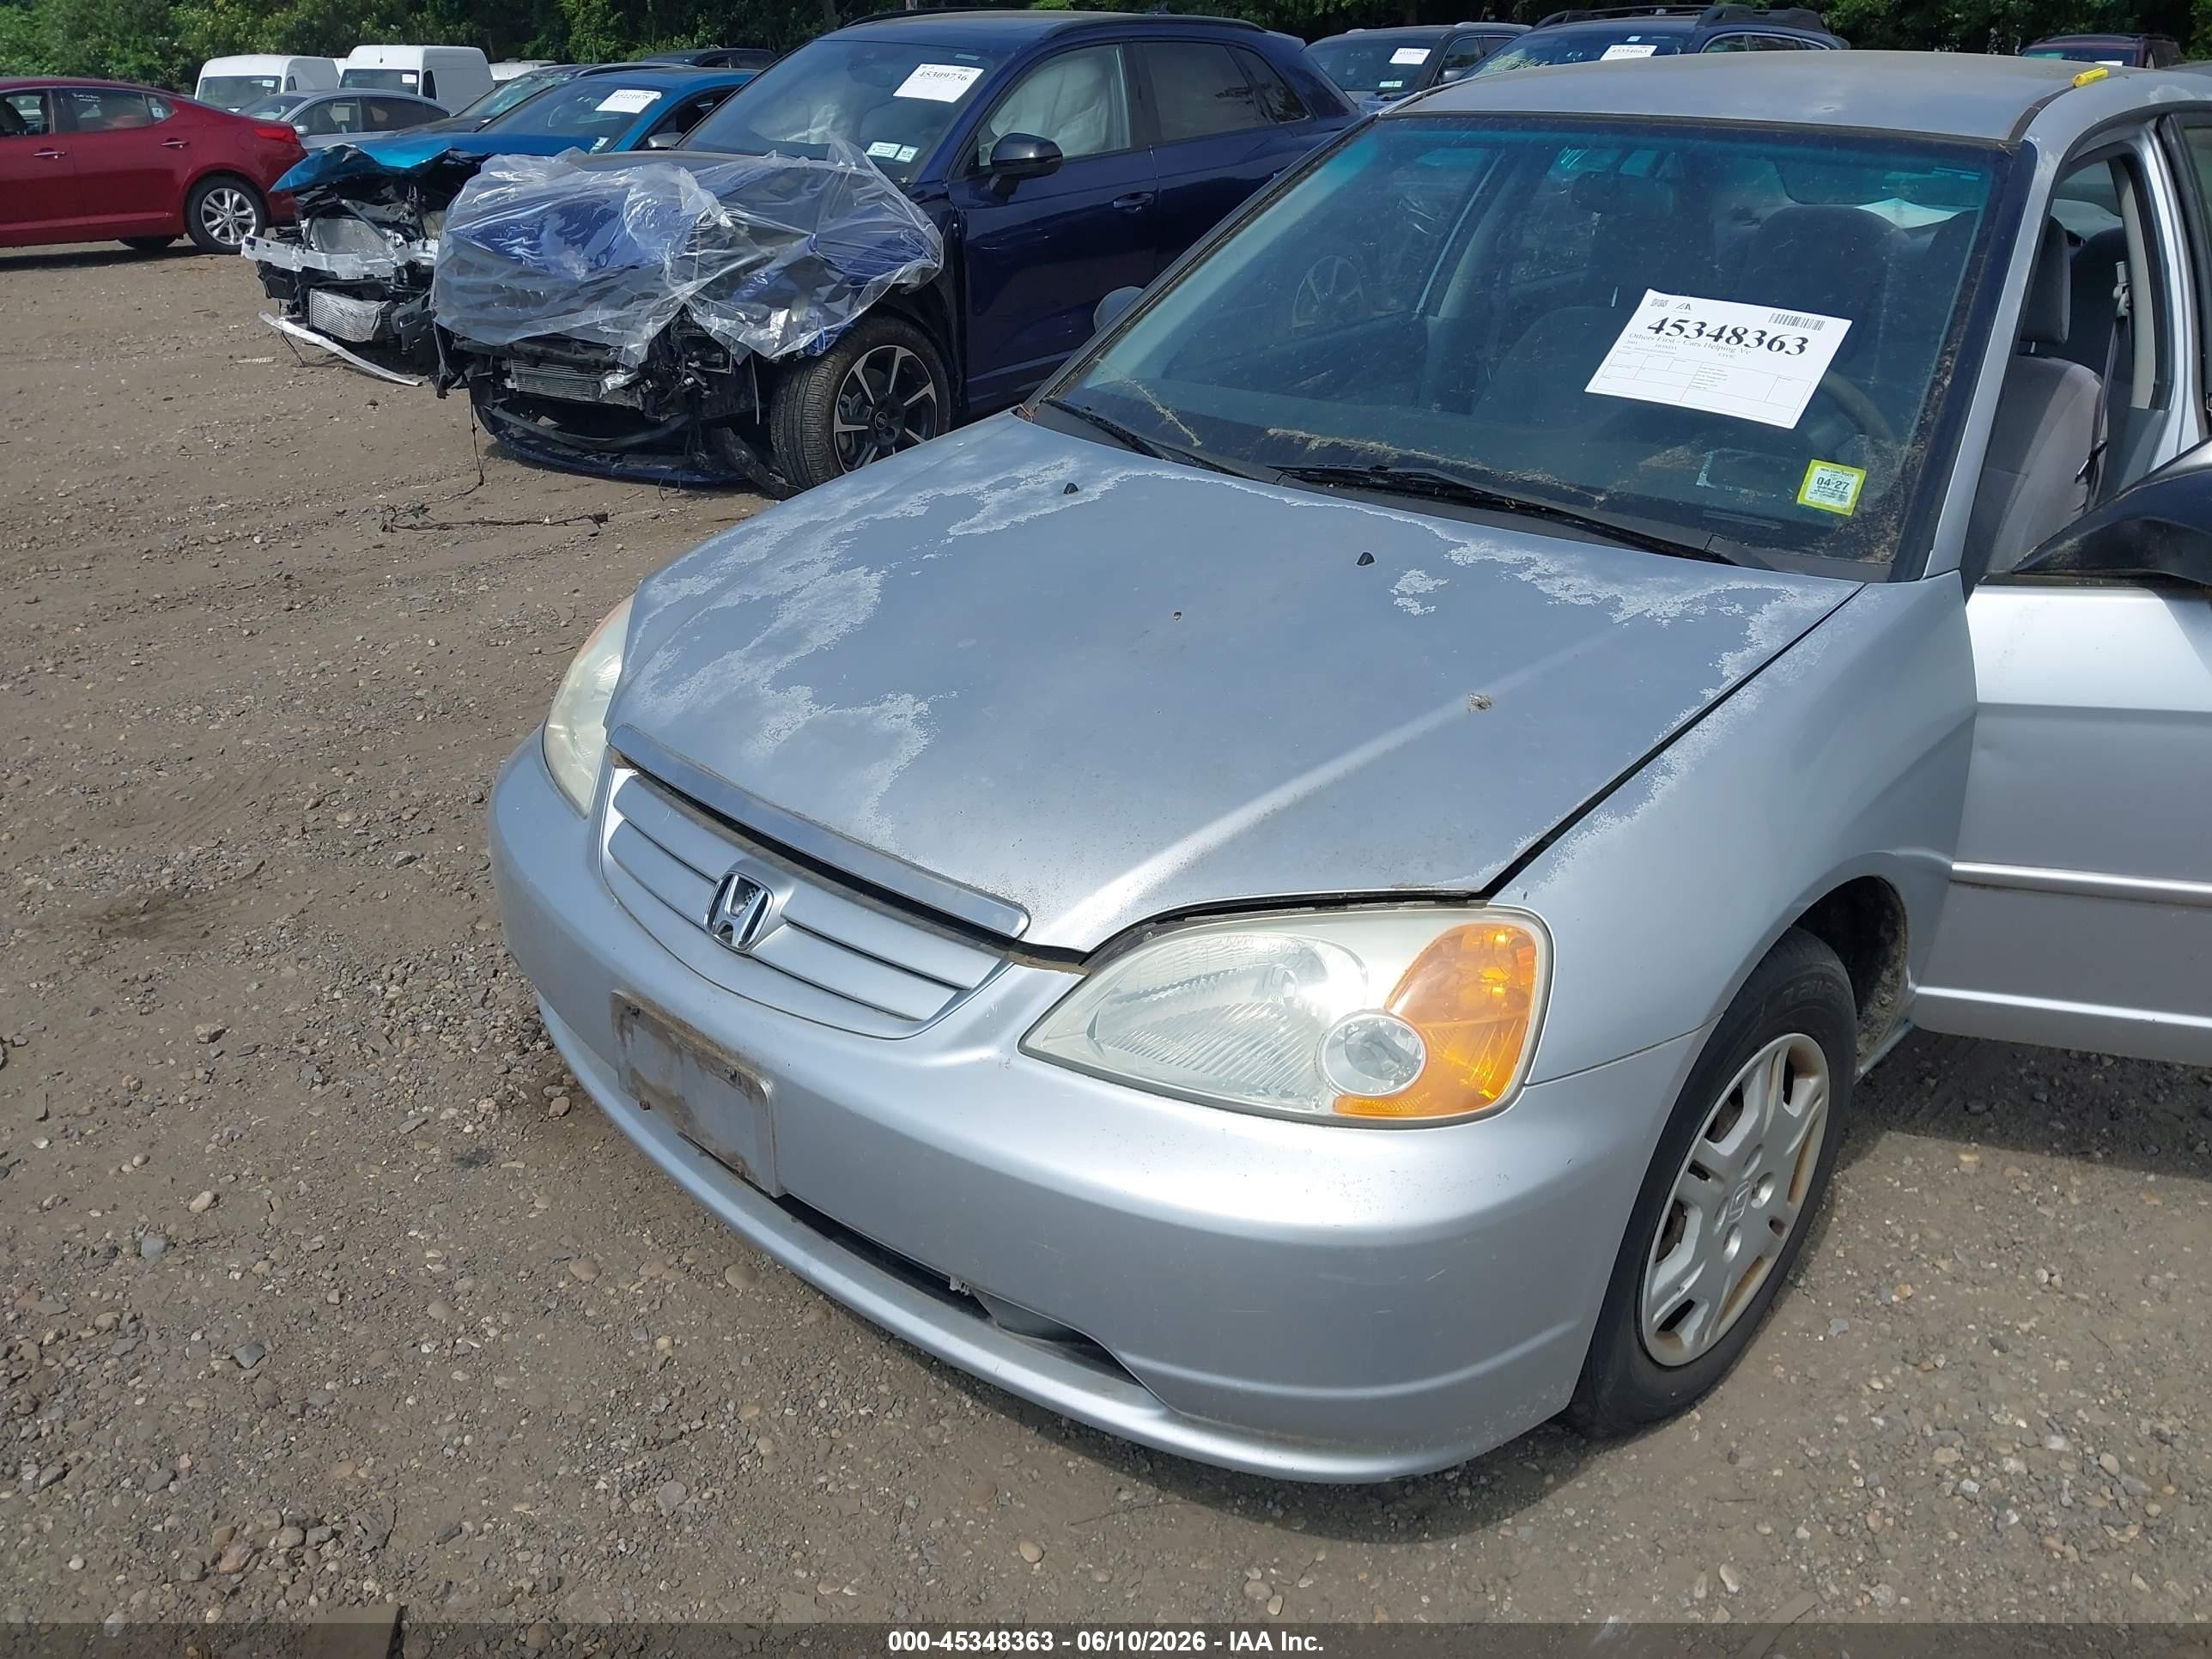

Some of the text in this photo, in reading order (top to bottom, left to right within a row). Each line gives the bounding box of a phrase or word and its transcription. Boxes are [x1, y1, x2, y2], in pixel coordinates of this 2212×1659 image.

[918, 70, 969, 82] 45309736
[1629, 332, 1656, 342] Others
[1656, 336, 1675, 344] First
[1704, 342, 1736, 354] Helping
[1646, 316, 1809, 356] 45348363
